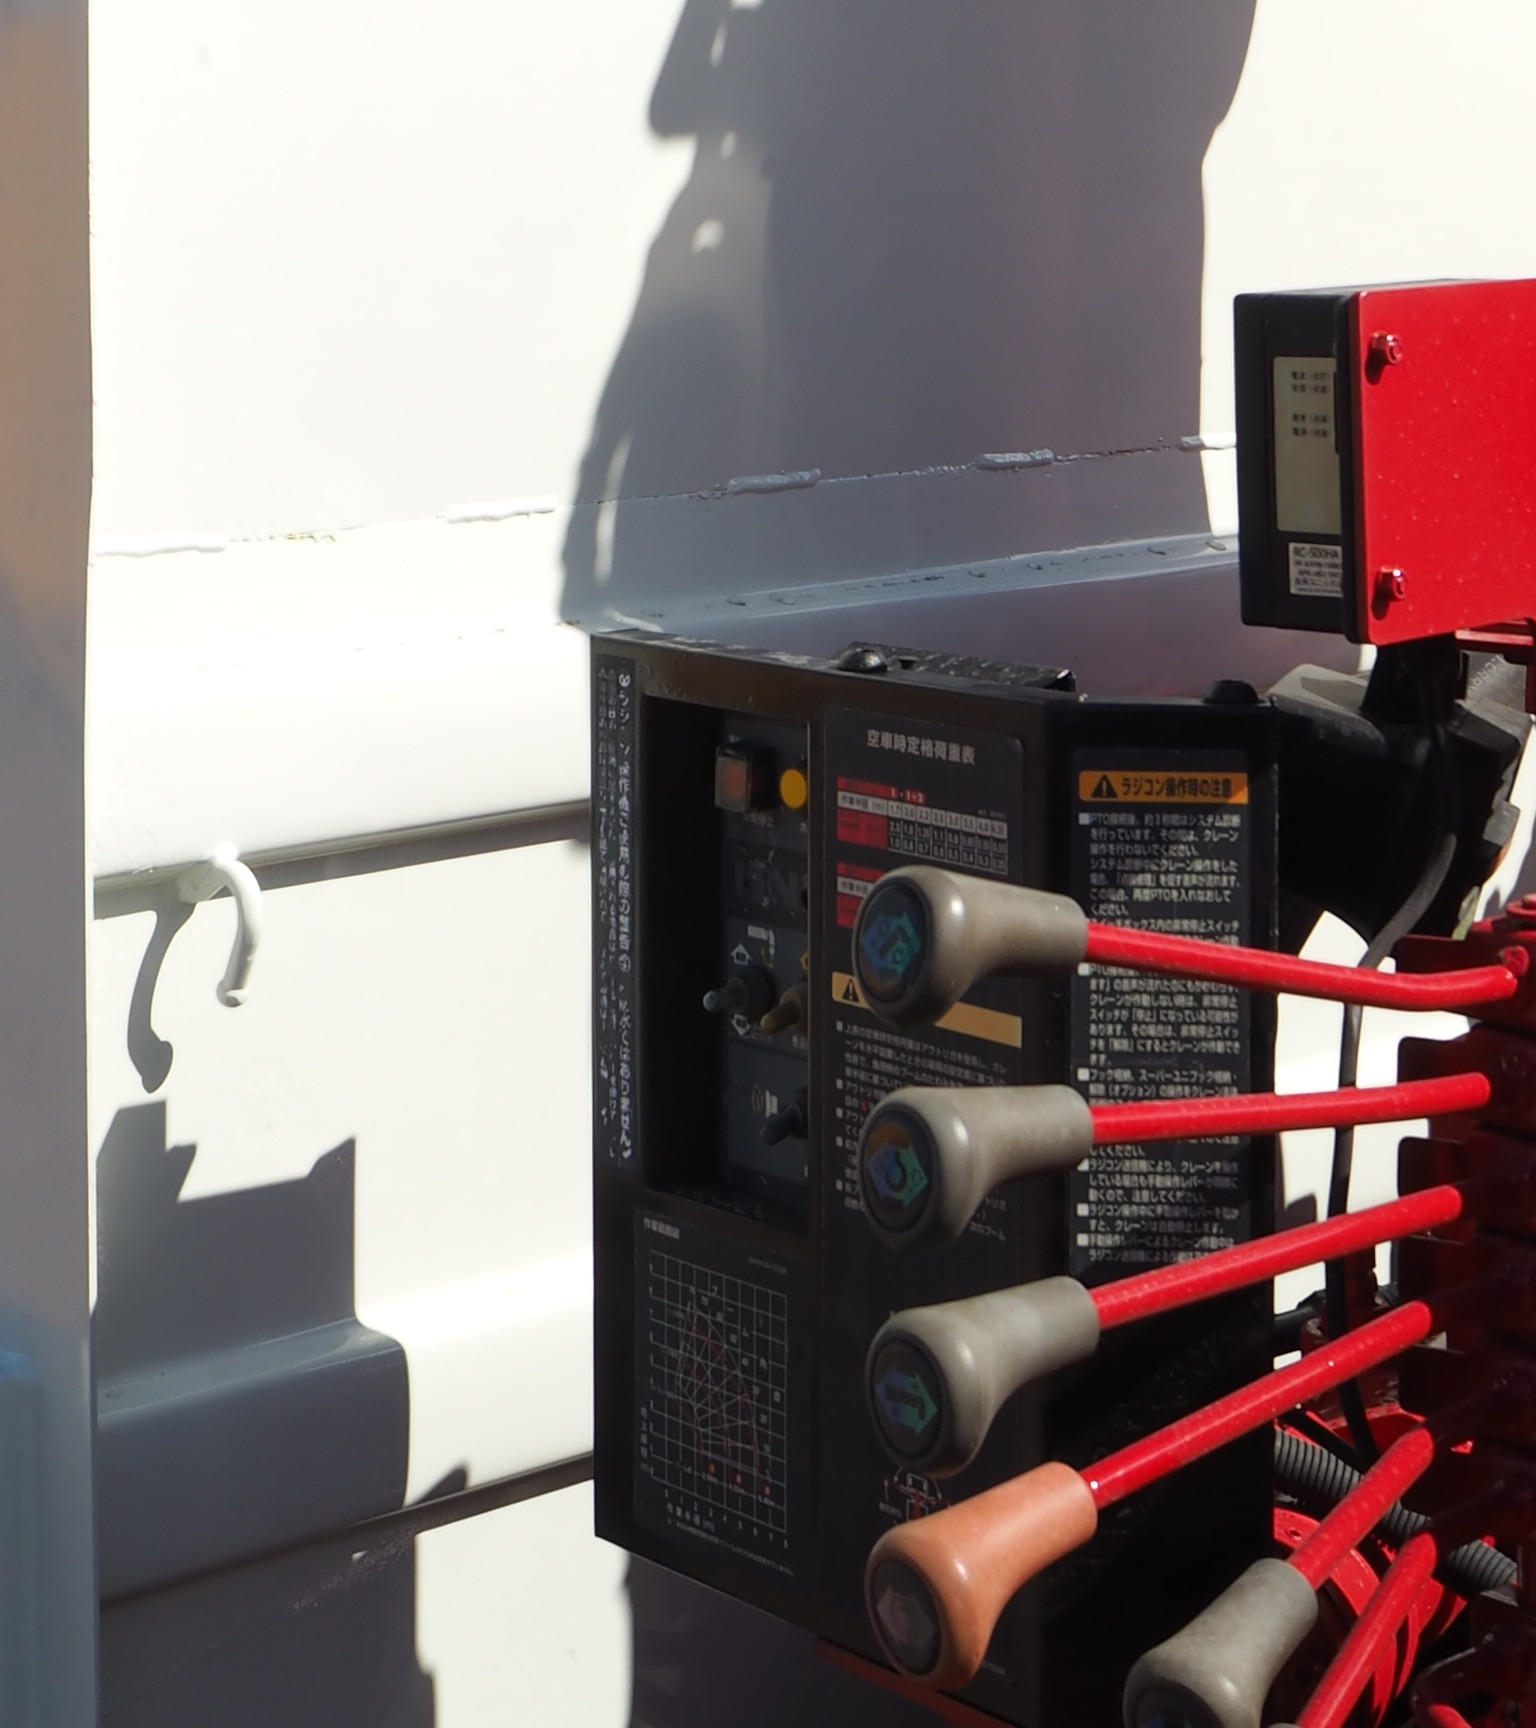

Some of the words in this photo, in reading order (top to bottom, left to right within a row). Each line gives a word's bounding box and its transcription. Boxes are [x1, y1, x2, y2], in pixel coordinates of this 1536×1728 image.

[866, 728, 976, 765] 空車時定格荷重表
[1121, 776, 1232, 799] ラジコン操作時の注意
